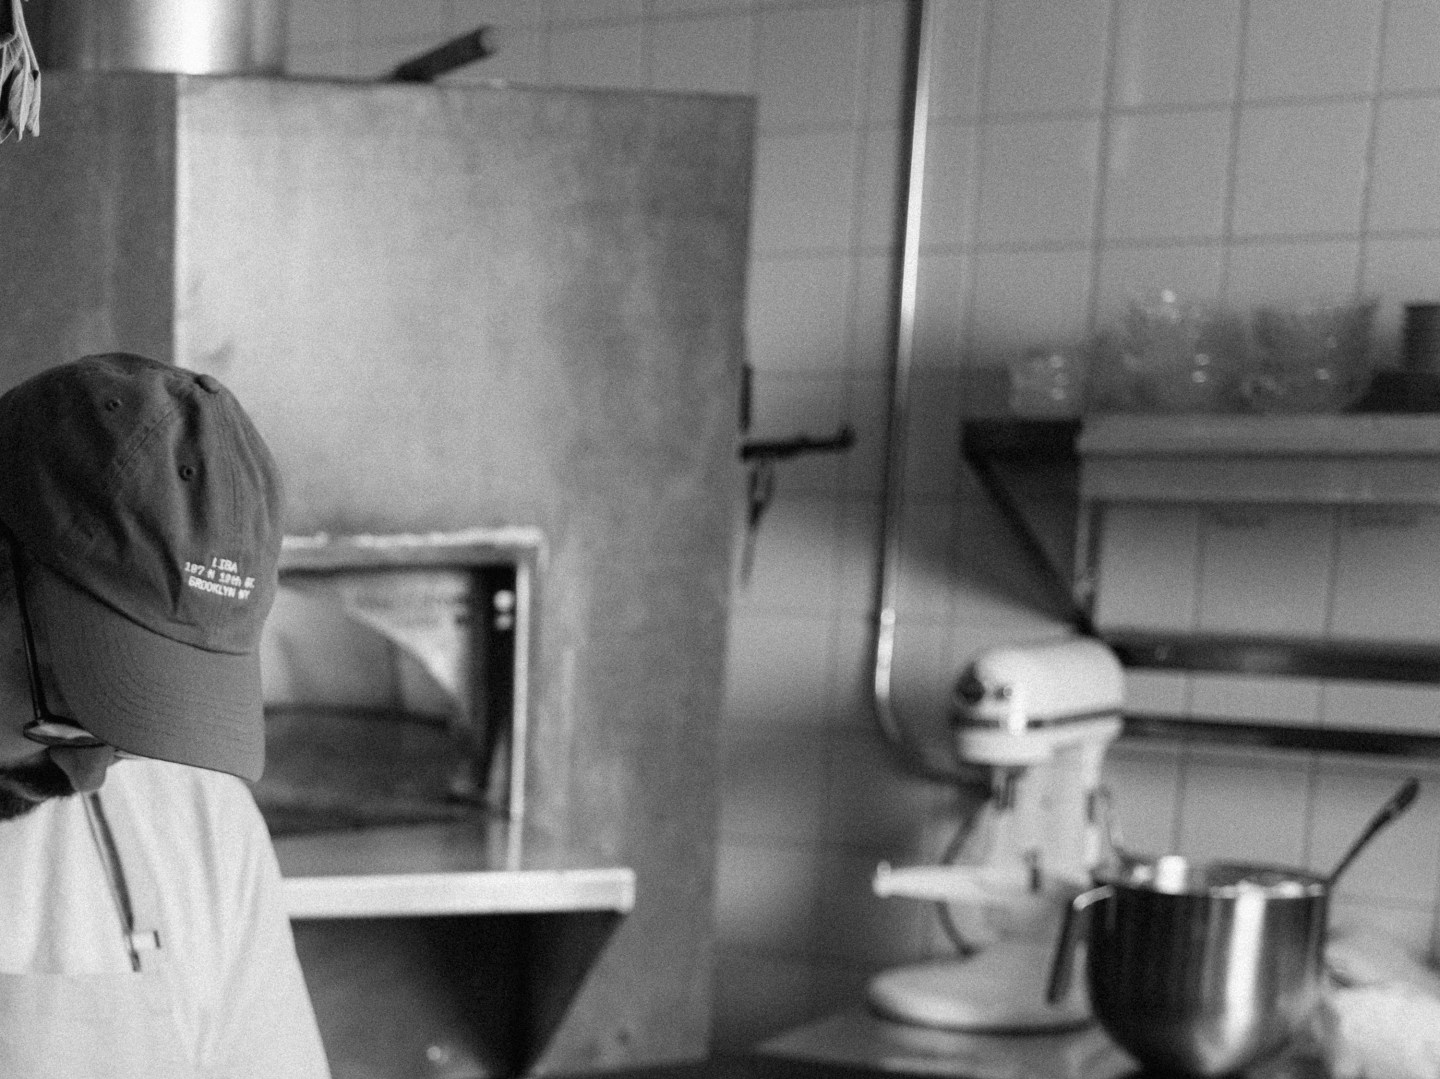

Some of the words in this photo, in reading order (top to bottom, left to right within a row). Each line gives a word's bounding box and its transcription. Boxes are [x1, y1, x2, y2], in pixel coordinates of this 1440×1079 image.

[212, 556, 238, 573] LIBA
[207, 568, 216, 580] N
[188, 575, 236, 598] BROOKLYN
[238, 589, 251, 600] NY
